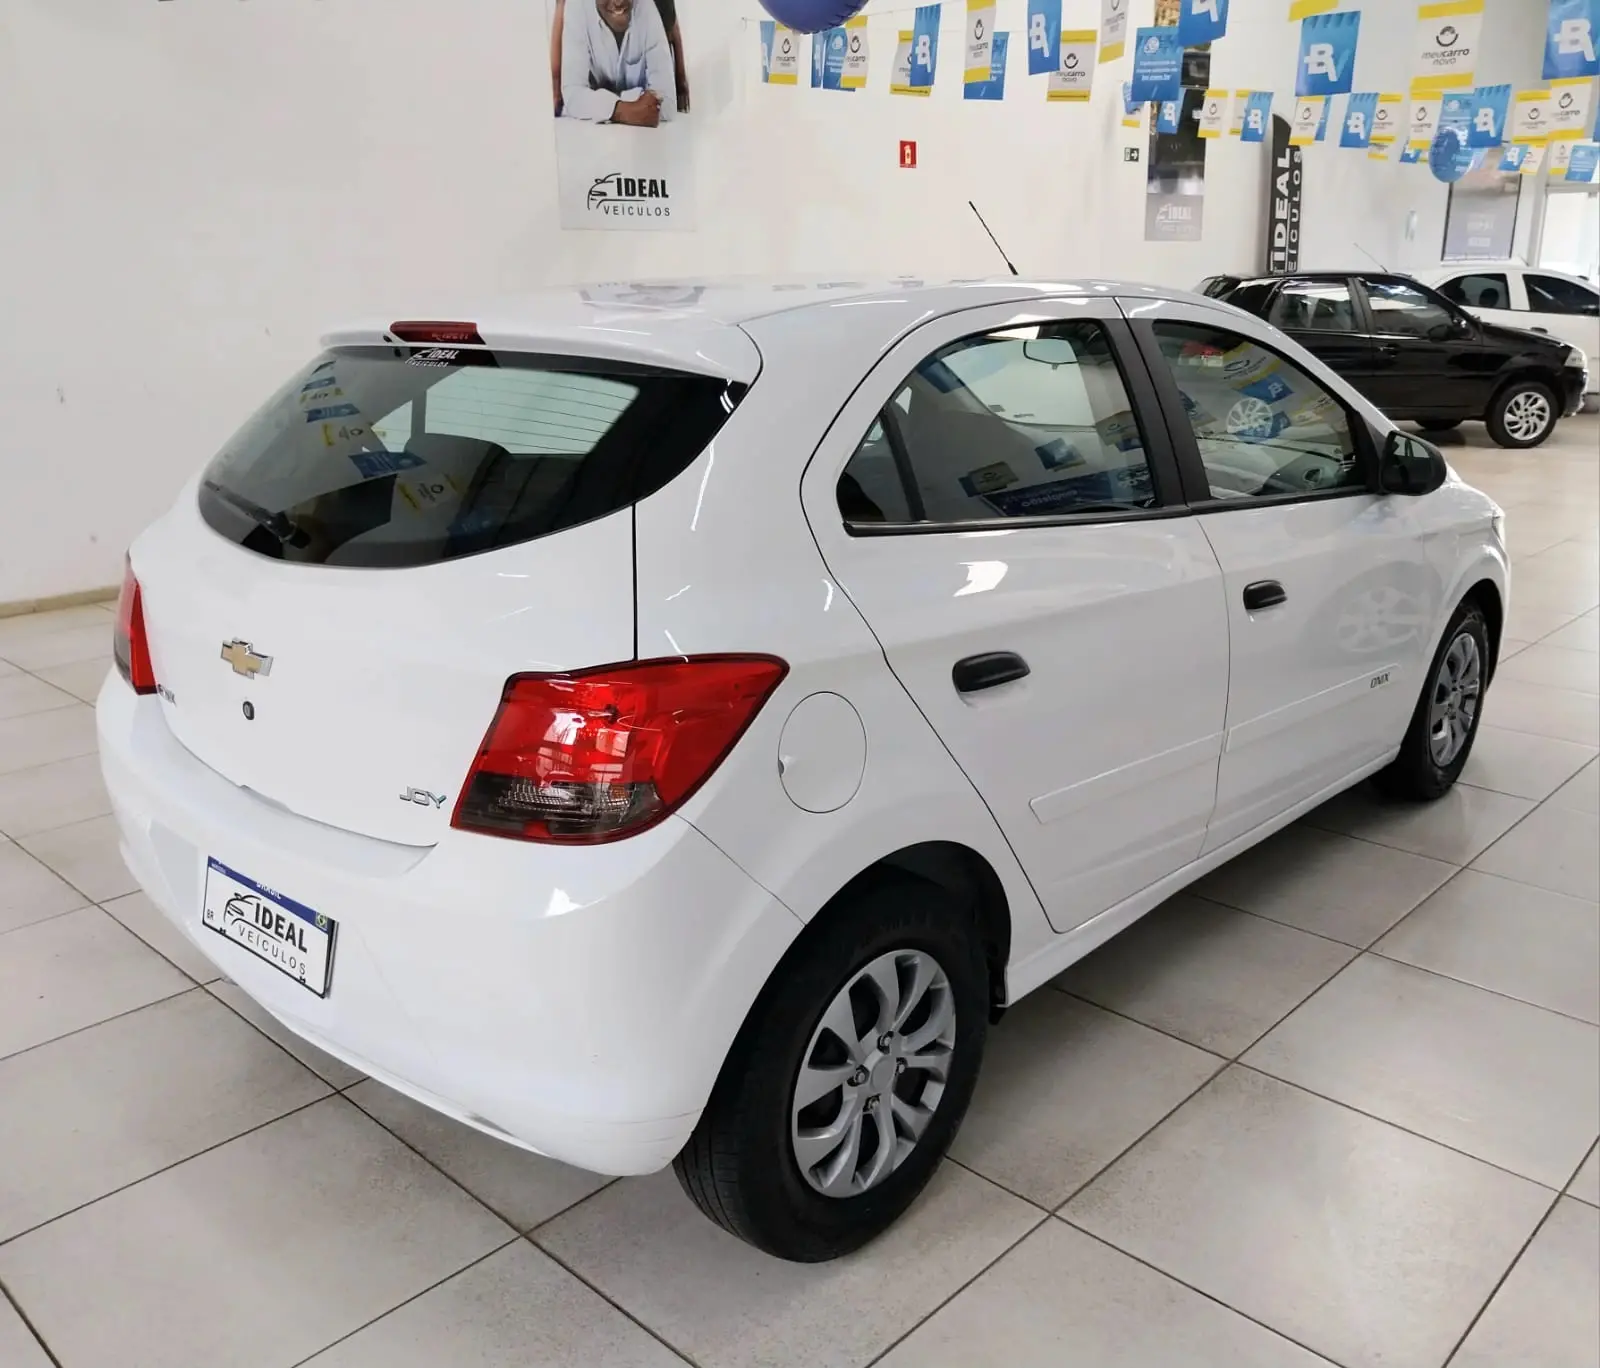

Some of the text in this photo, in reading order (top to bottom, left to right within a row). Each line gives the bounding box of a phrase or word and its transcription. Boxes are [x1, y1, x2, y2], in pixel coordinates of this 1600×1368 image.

[1421, 48, 1470, 59] meucarro
[1432, 57, 1457, 66] novo
[616, 177, 669, 198] IDEAL
[1273, 147, 1291, 262] IDEAL
[427, 349, 460, 360] IDEAL
[399, 785, 447, 809] JOY
[254, 902, 308, 954] IDEAL
